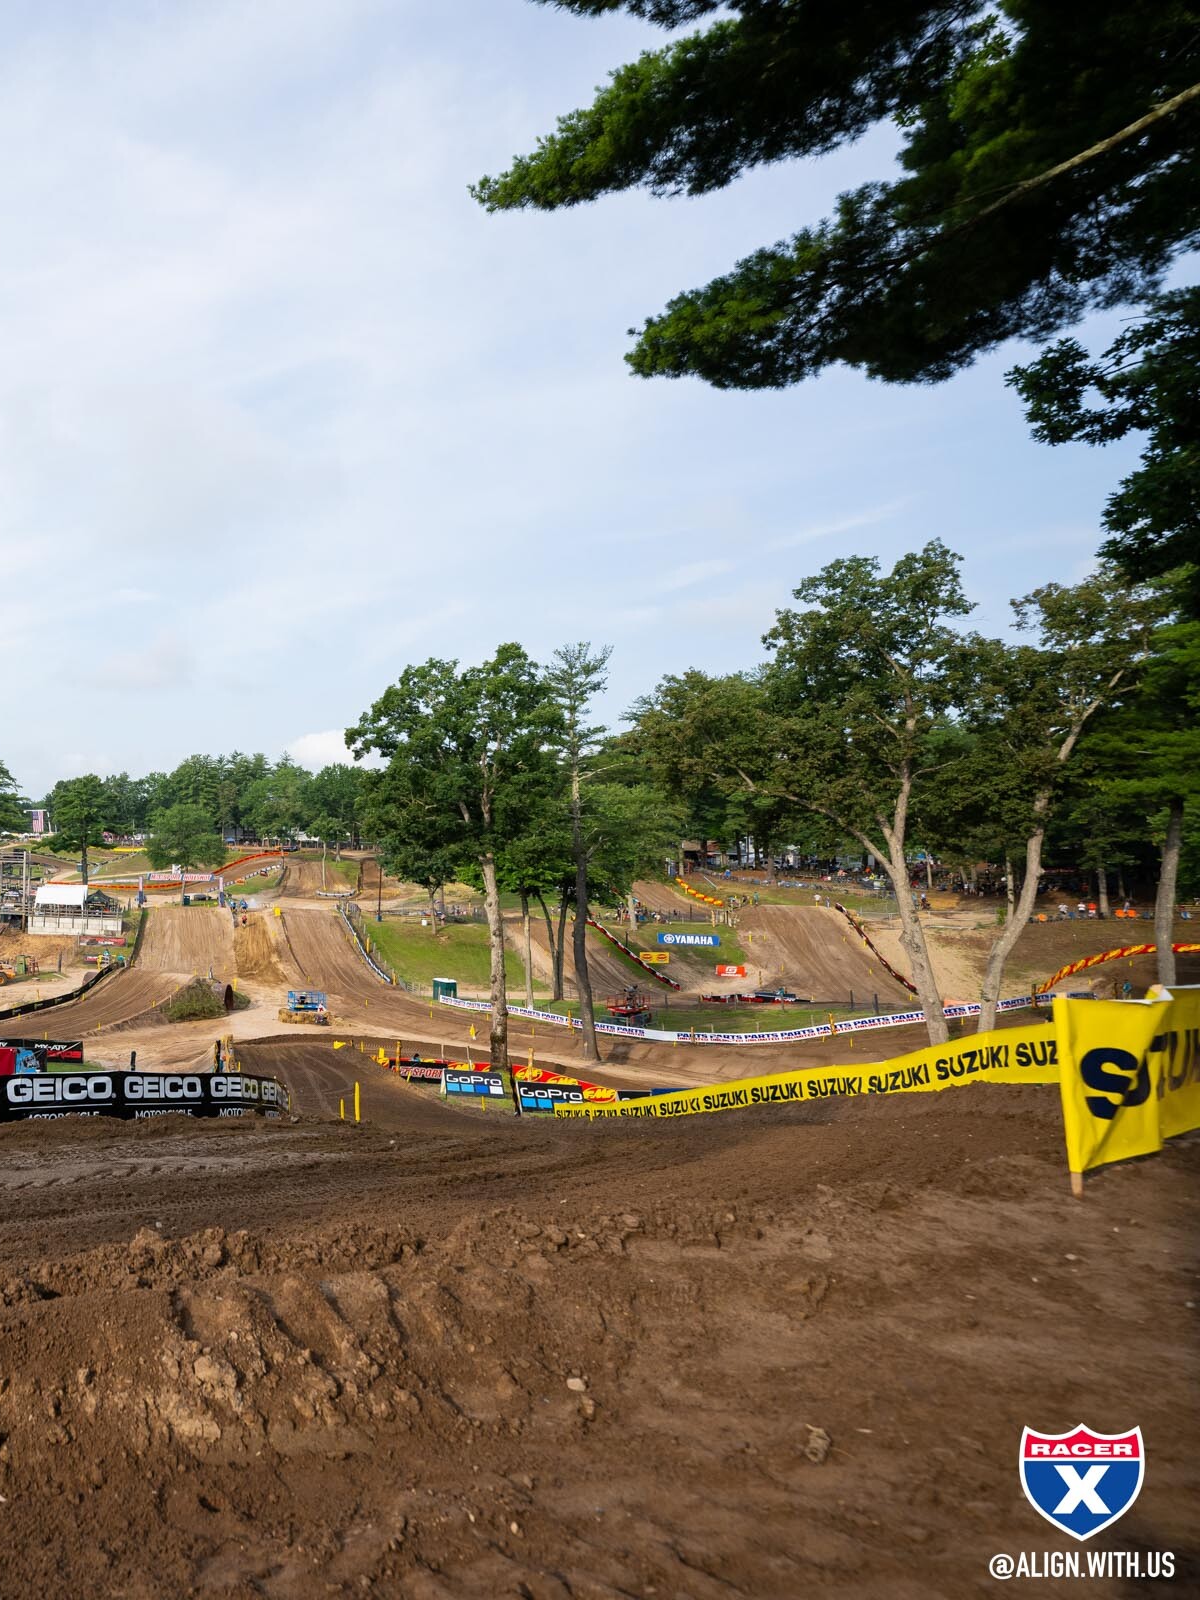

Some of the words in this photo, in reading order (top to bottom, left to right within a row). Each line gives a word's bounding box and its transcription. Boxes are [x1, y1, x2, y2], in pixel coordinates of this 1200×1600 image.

[674, 934, 714, 945] YAMAHA
[944, 1006, 966, 1014] RTS
[595, 1023, 616, 1031] ARTS
[780, 1029, 814, 1038] PARTS
[854, 1016, 890, 1027] PARTS
[446, 1074, 502, 1086] GoPro
[660, 1098, 700, 1116] SUZUKI
[704, 1089, 748, 1110] SUZUKI
[751, 1082, 803, 1103] SUZUKI
[807, 1076, 862, 1097] SUZUKI
[868, 1063, 930, 1094] SUZUKI
[935, 1045, 1009, 1081] SUZUKI
[1016, 1040, 1058, 1067] SUZ
[6, 1076, 113, 1102] GEICO
[124, 1076, 201, 1099] GEICO
[520, 1087, 583, 1100] GoPro
